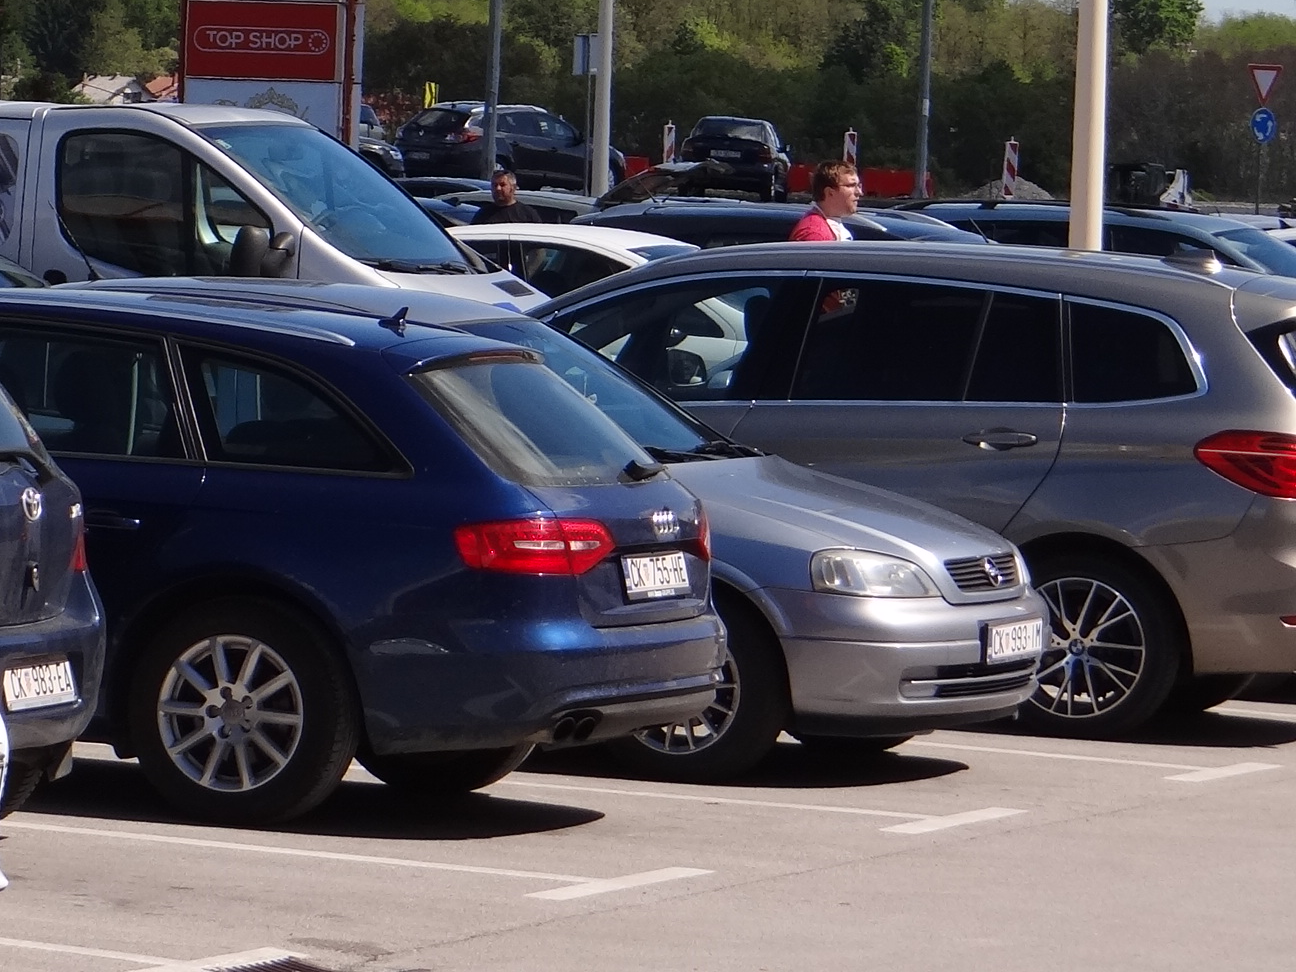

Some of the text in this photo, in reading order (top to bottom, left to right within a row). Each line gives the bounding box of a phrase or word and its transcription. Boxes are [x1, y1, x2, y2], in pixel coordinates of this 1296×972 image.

[206, 30, 304, 50] TOP SHOP
[649, 556, 686, 585] 755-HE
